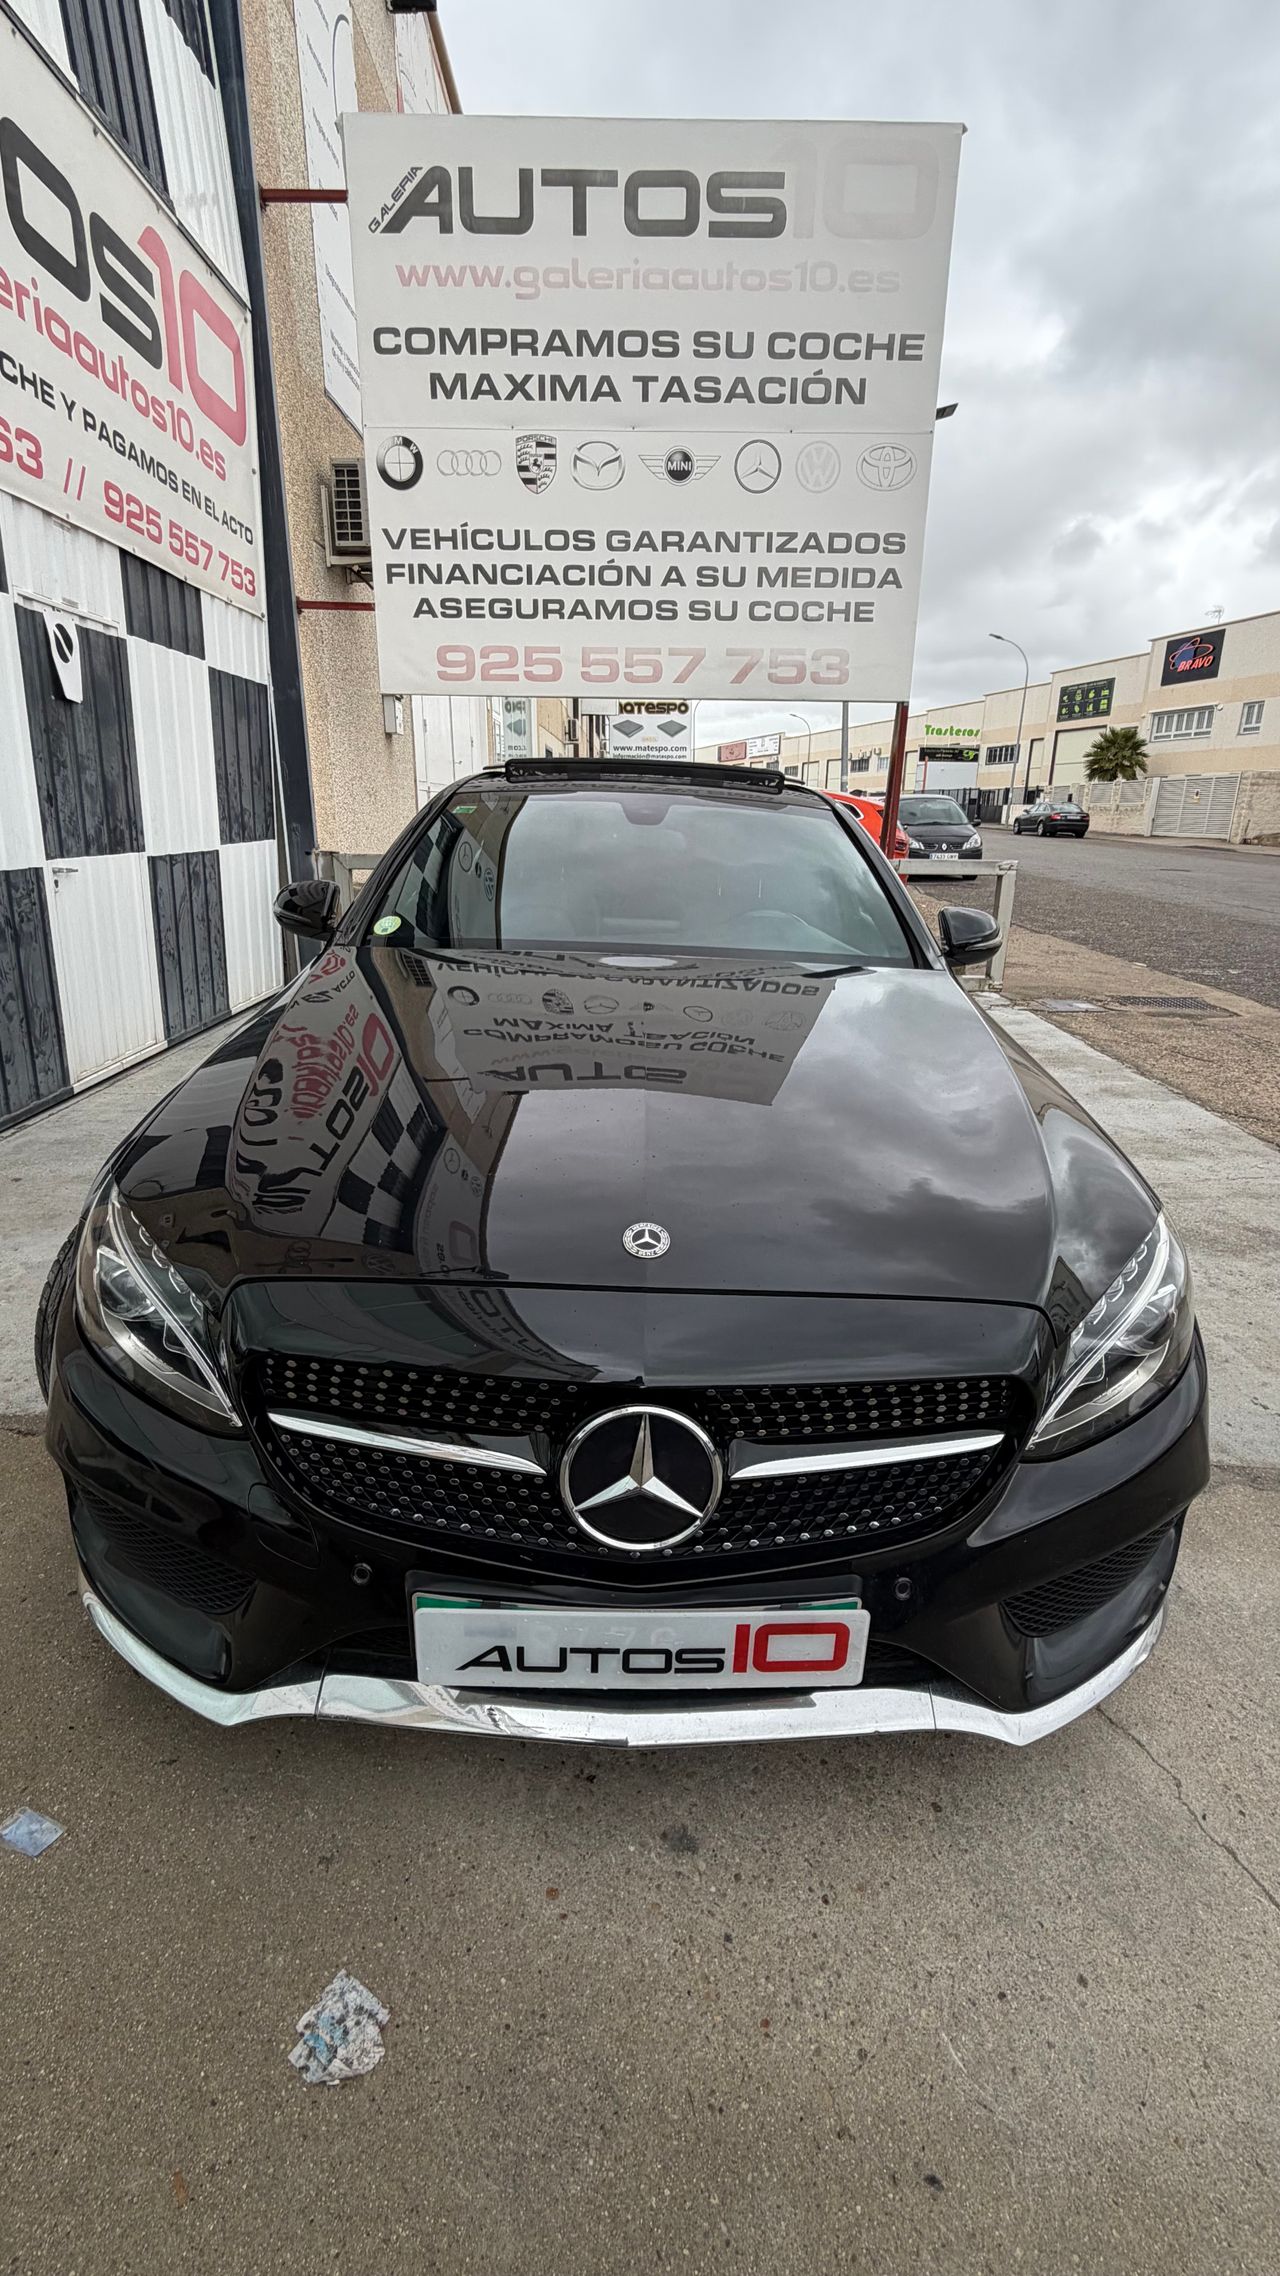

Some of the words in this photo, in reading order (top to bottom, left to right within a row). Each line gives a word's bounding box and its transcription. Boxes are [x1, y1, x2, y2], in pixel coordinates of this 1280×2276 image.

[368, 165, 424, 234] GALERIA
[396, 257, 900, 300] www.galeriaautos10.es
[372, 326, 681, 359] COMPRAMOS
[692, 330, 754, 361] SU
[767, 332, 926, 362] COCHE
[430, 373, 622, 403] MAXIMA
[632, 369, 867, 405] TASACIÓN
[60, 392, 77, 422] Y
[83, 408, 179, 494] PAGAMOS
[182, 479, 202, 511] EN
[204, 496, 220, 523] EL
[221, 517, 254, 546] ACTO
[667, 460, 692, 471] MINI
[103, 480, 163, 545] 925
[168, 519, 213, 573] 557
[218, 551, 256, 597] 753
[382, 521, 596, 552] VEHÍCULOS
[606, 529, 907, 555] GARANTIZADOS
[385, 558, 652, 587] FINANCIACIÓN
[661, 566, 687, 588] A
[696, 565, 745, 589] SU
[756, 566, 903, 590] MEDIDA
[412, 597, 679, 622] ASEGURAMOS
[688, 599, 738, 622] SU
[748, 600, 875, 623] COCHE
[436, 645, 563, 683] 925
[580, 647, 706, 684] 557
[727, 648, 850, 686] 753
[1177, 655, 1214, 672] BRAVO
[612, 745, 688, 753] www.matespo.com
[924, 724, 981, 738] Trasteros
[455, 1621, 851, 1674] AUTOS10
